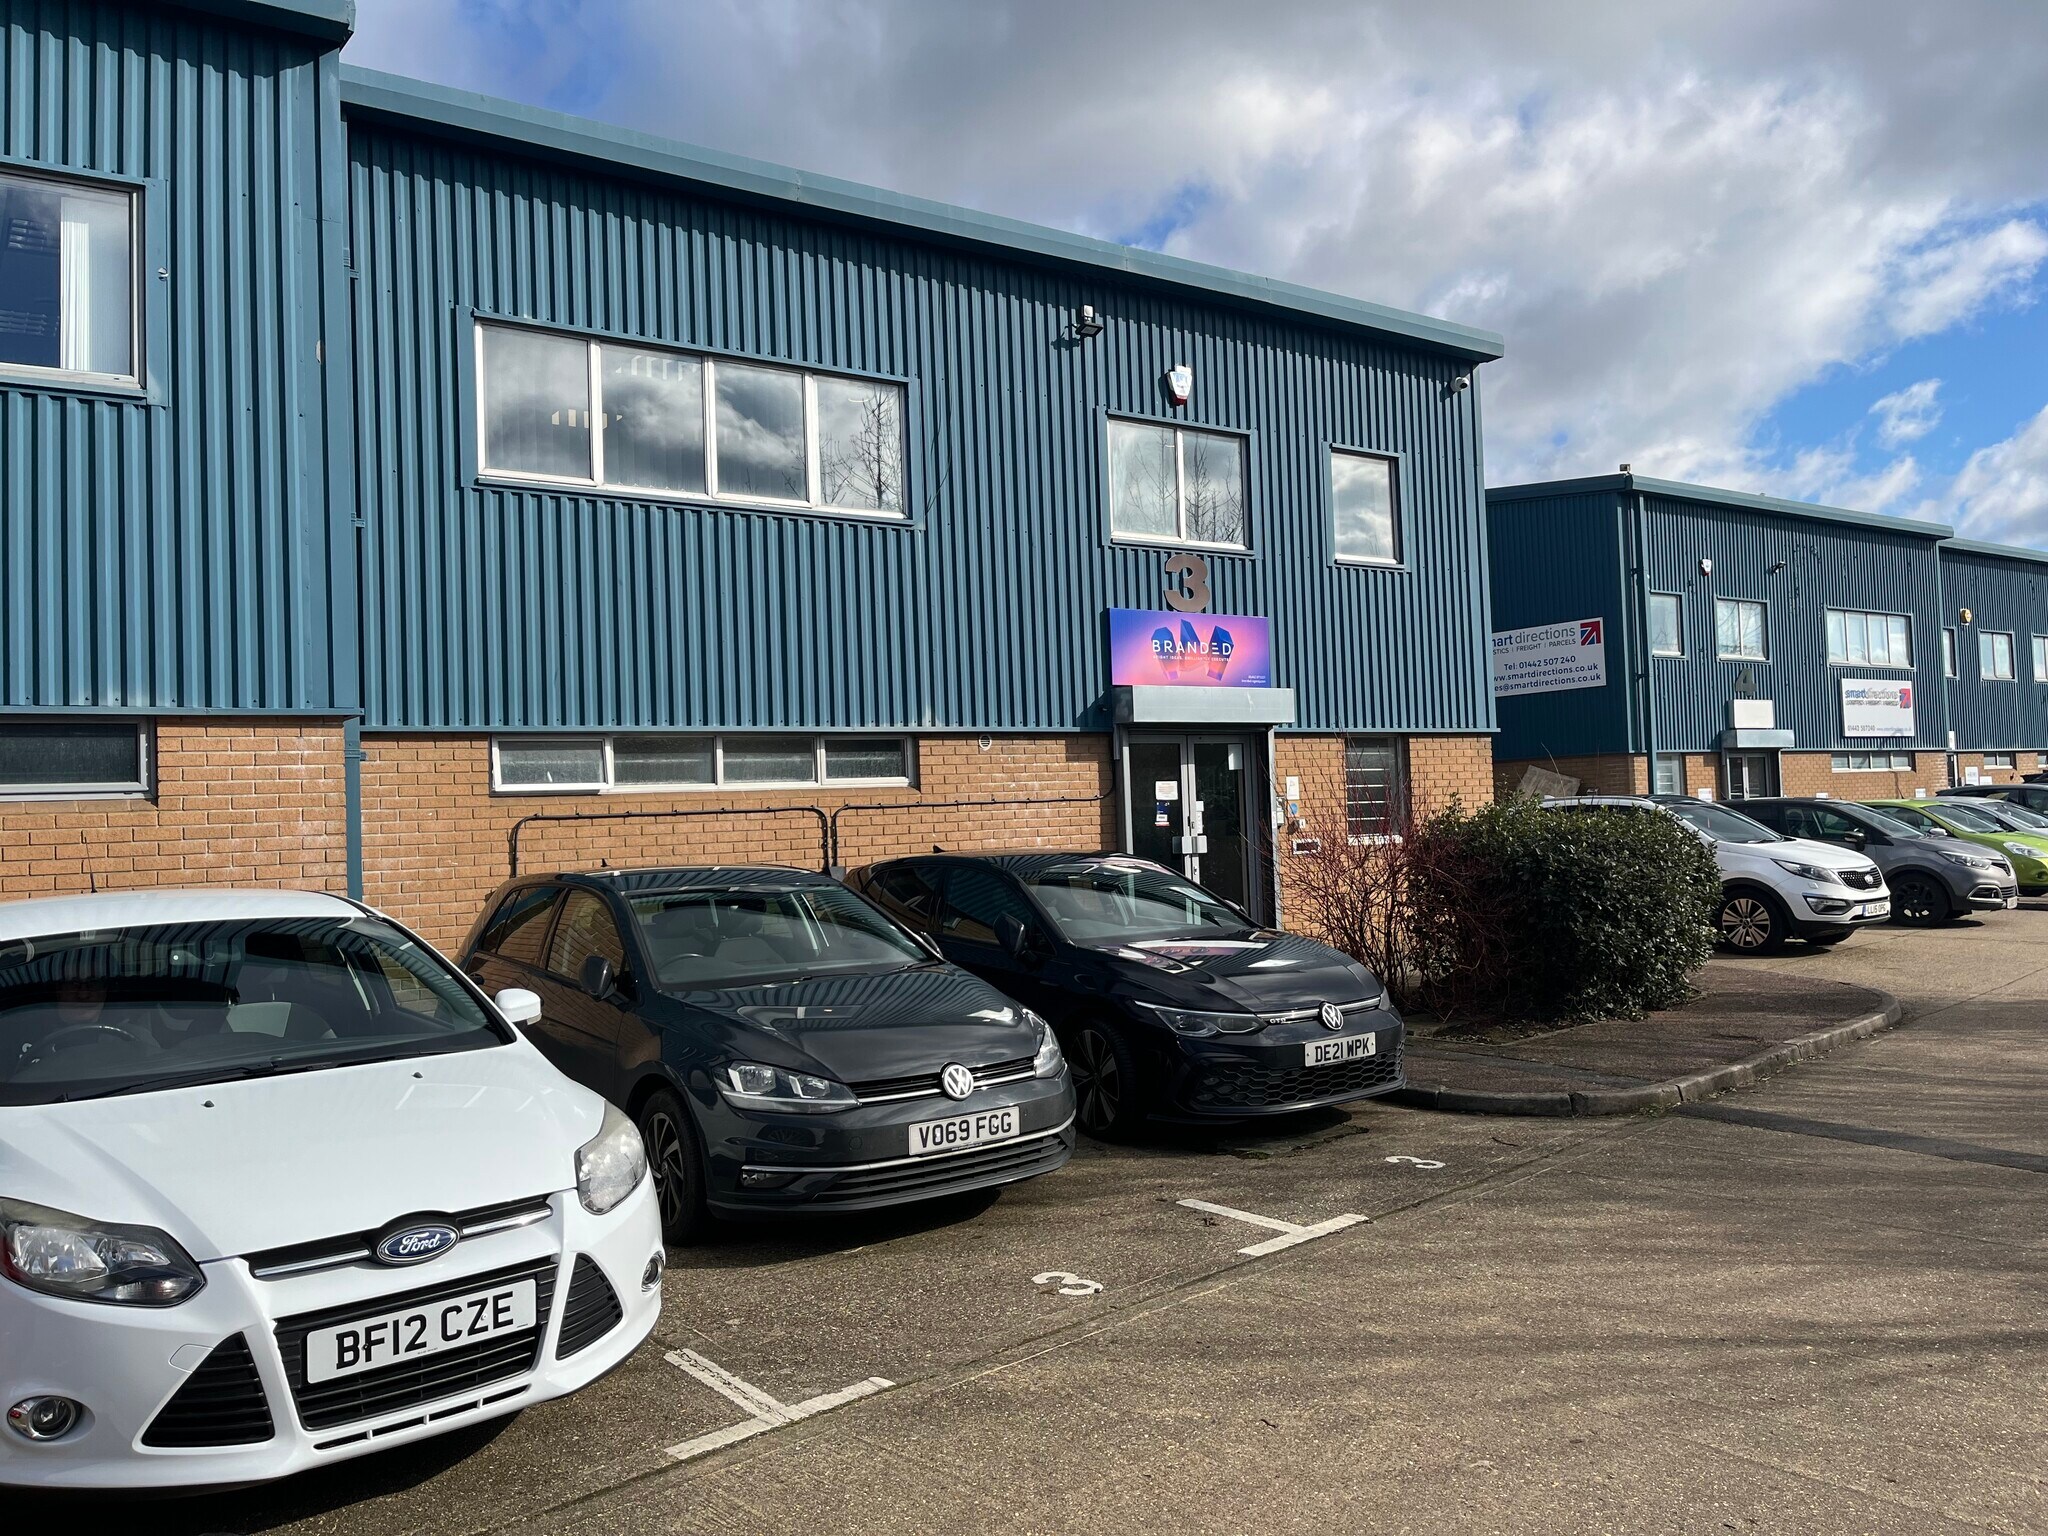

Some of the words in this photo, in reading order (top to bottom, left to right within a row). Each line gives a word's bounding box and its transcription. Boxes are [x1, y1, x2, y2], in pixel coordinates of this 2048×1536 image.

[1163, 553, 1211, 613] 3
[1152, 639, 1232, 655] BRANDED
[1492, 635, 1513, 648] art
[1515, 627, 1575, 644] directions
[1493, 647, 1510, 655] STICS
[1516, 643, 1541, 652] FREIGHT
[1549, 639, 1576, 648] PARCELS
[1493, 663, 1598, 682] ww.smartdirections.co.uk
[1504, 663, 1518, 671] Tel:
[1519, 660, 1542, 669] 01442
[1543, 658, 1559, 666] 507
[1560, 655, 1576, 664] 240
[1494, 673, 1601, 692] es@smartdirections.co.uk
[1735, 668, 1757, 698] 4
[1314, 1042, 1344, 1063] DE21
[1347, 1037, 1370, 1057] WPK
[919, 1120, 970, 1148] VO69
[976, 1112, 1012, 1138] FGG
[399, 1231, 441, 1254] Ford
[1030, 1271, 1104, 1296] 3
[335, 1313, 428, 1371] BF12
[440, 1291, 514, 1342] CZE
